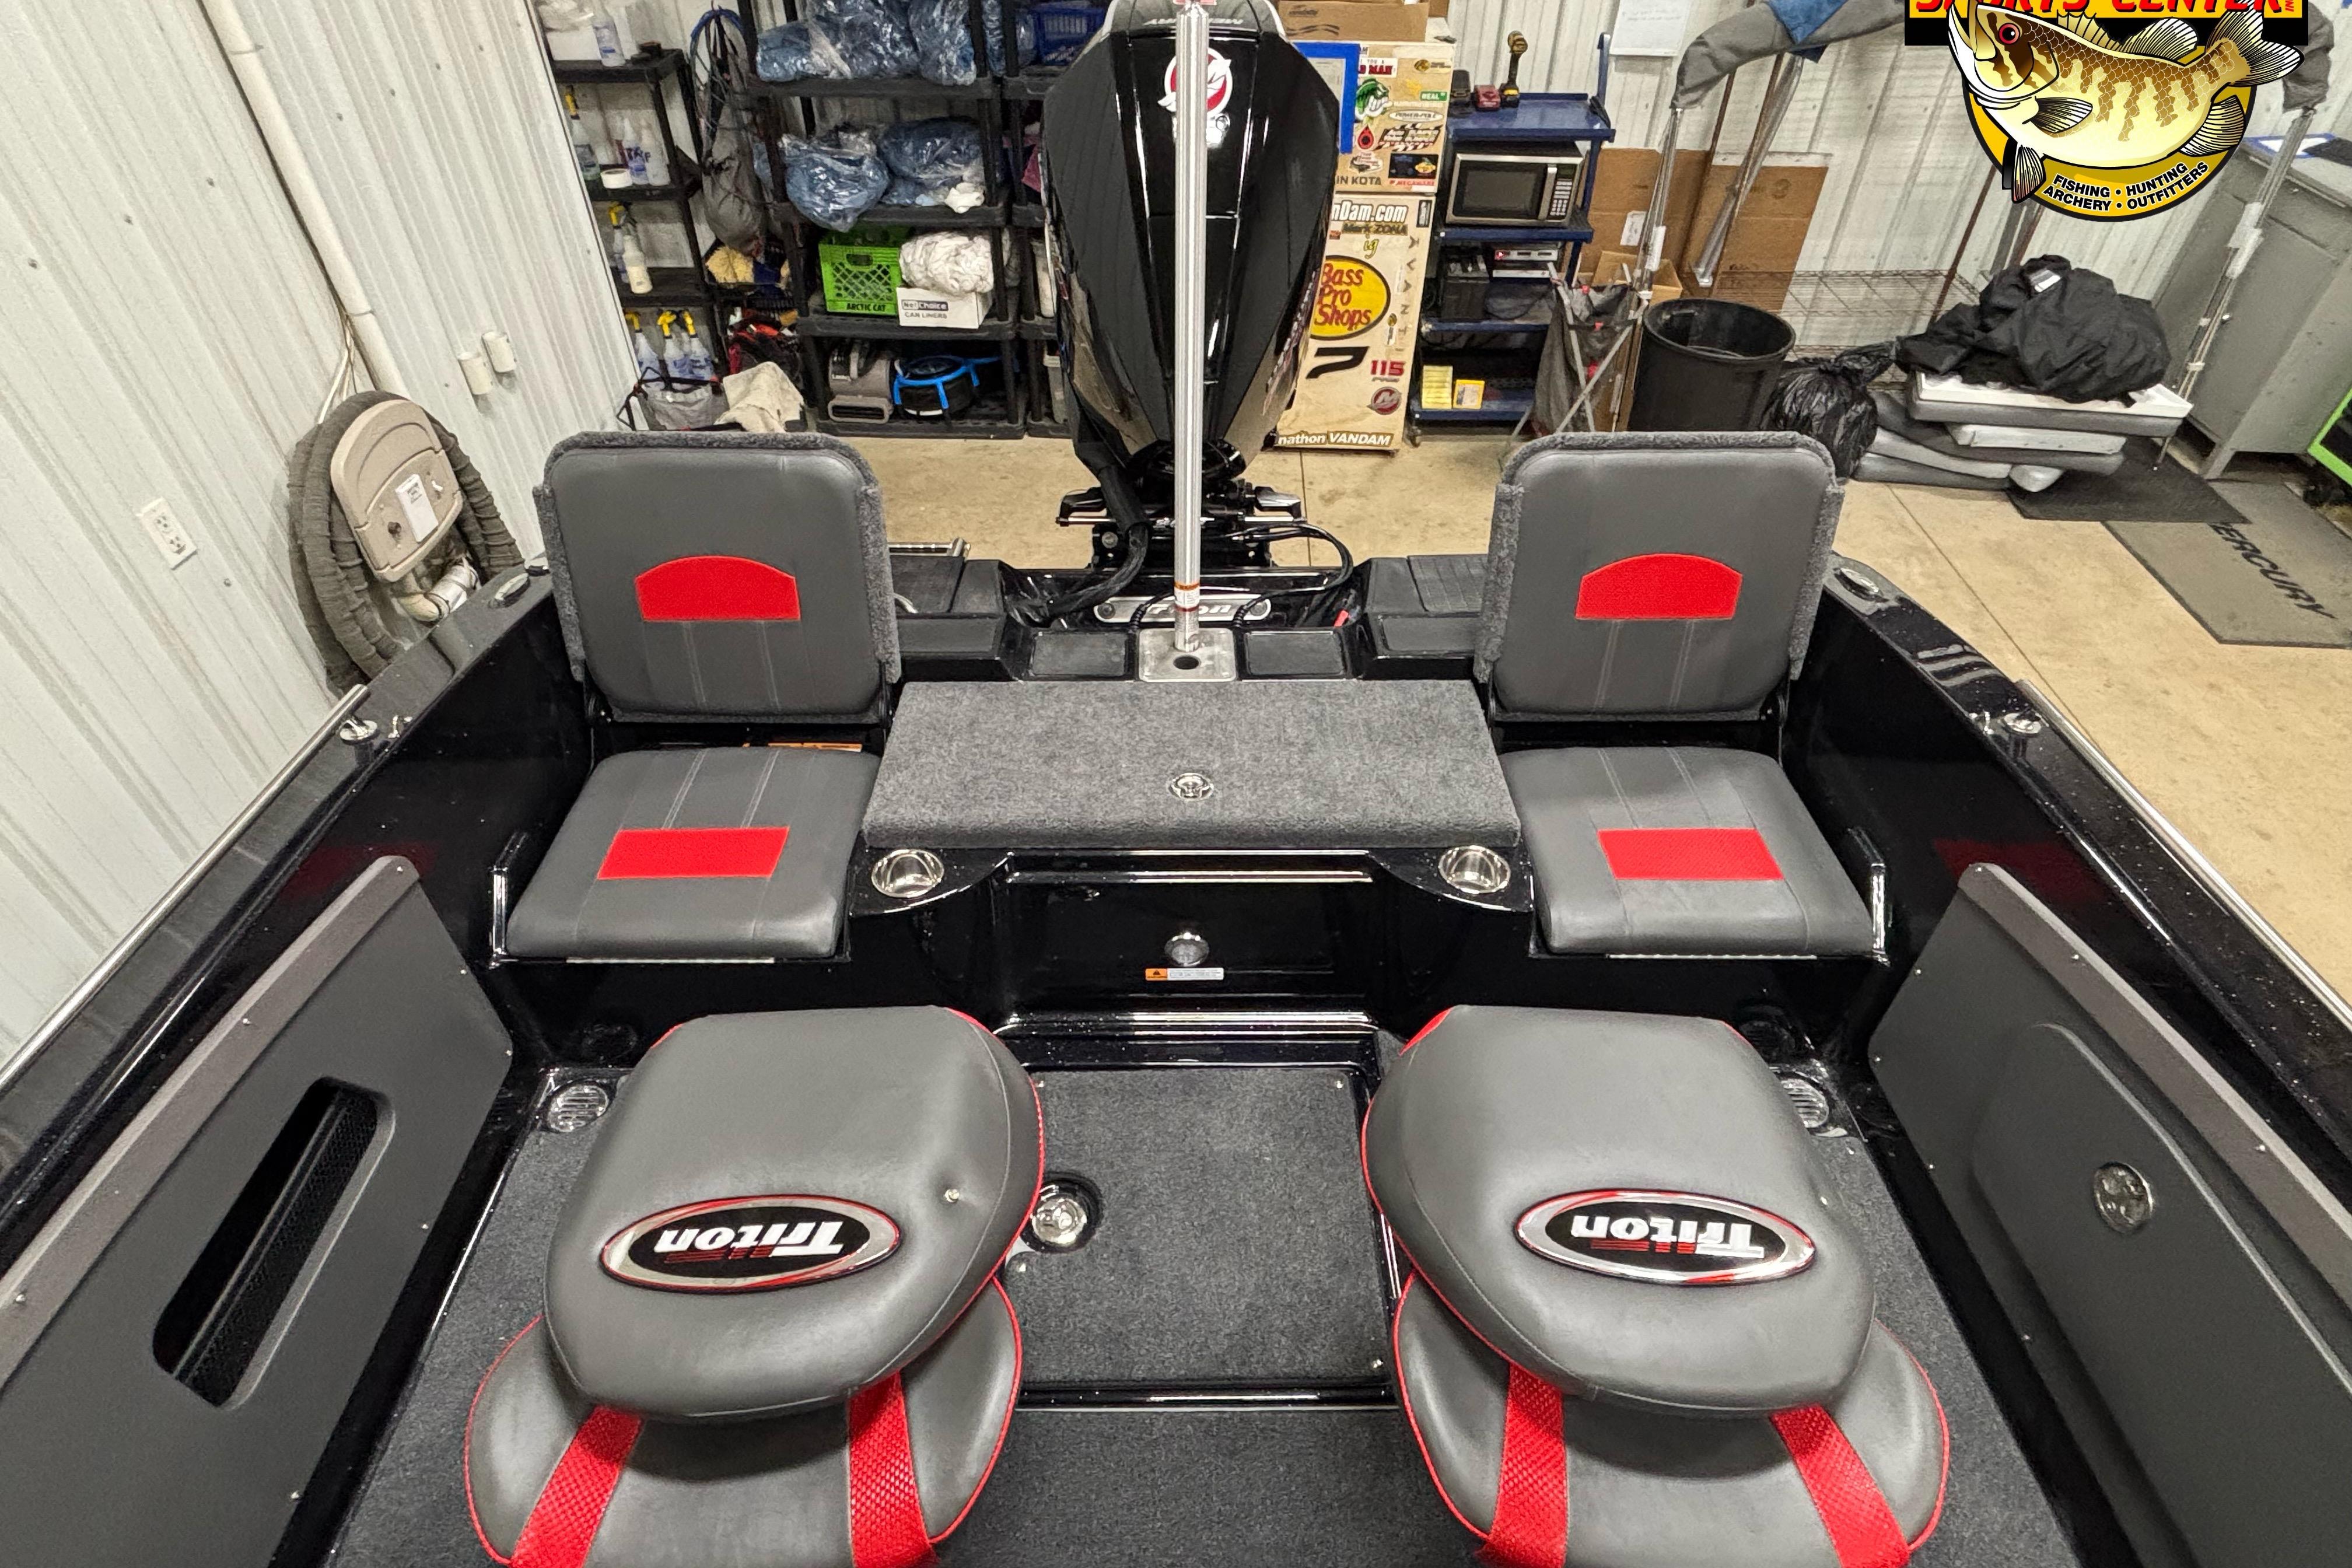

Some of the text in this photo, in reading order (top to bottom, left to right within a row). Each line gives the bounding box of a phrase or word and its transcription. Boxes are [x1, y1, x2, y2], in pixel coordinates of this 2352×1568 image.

[1351, 176, 1381, 186] KOTA
[1321, 262, 1364, 286] Bass
[1316, 284, 1352, 307] Pro
[846, 303, 887, 312] ARCTIC CAT
[1314, 303, 1373, 331] Shops
[1370, 359, 1406, 377] 115
[1278, 432, 1392, 446] nathon VANDAM
[2206, 523, 2339, 620] ERCURY
[653, 1220, 844, 1260] Triton
[1570, 1215, 1765, 1259] Triton
